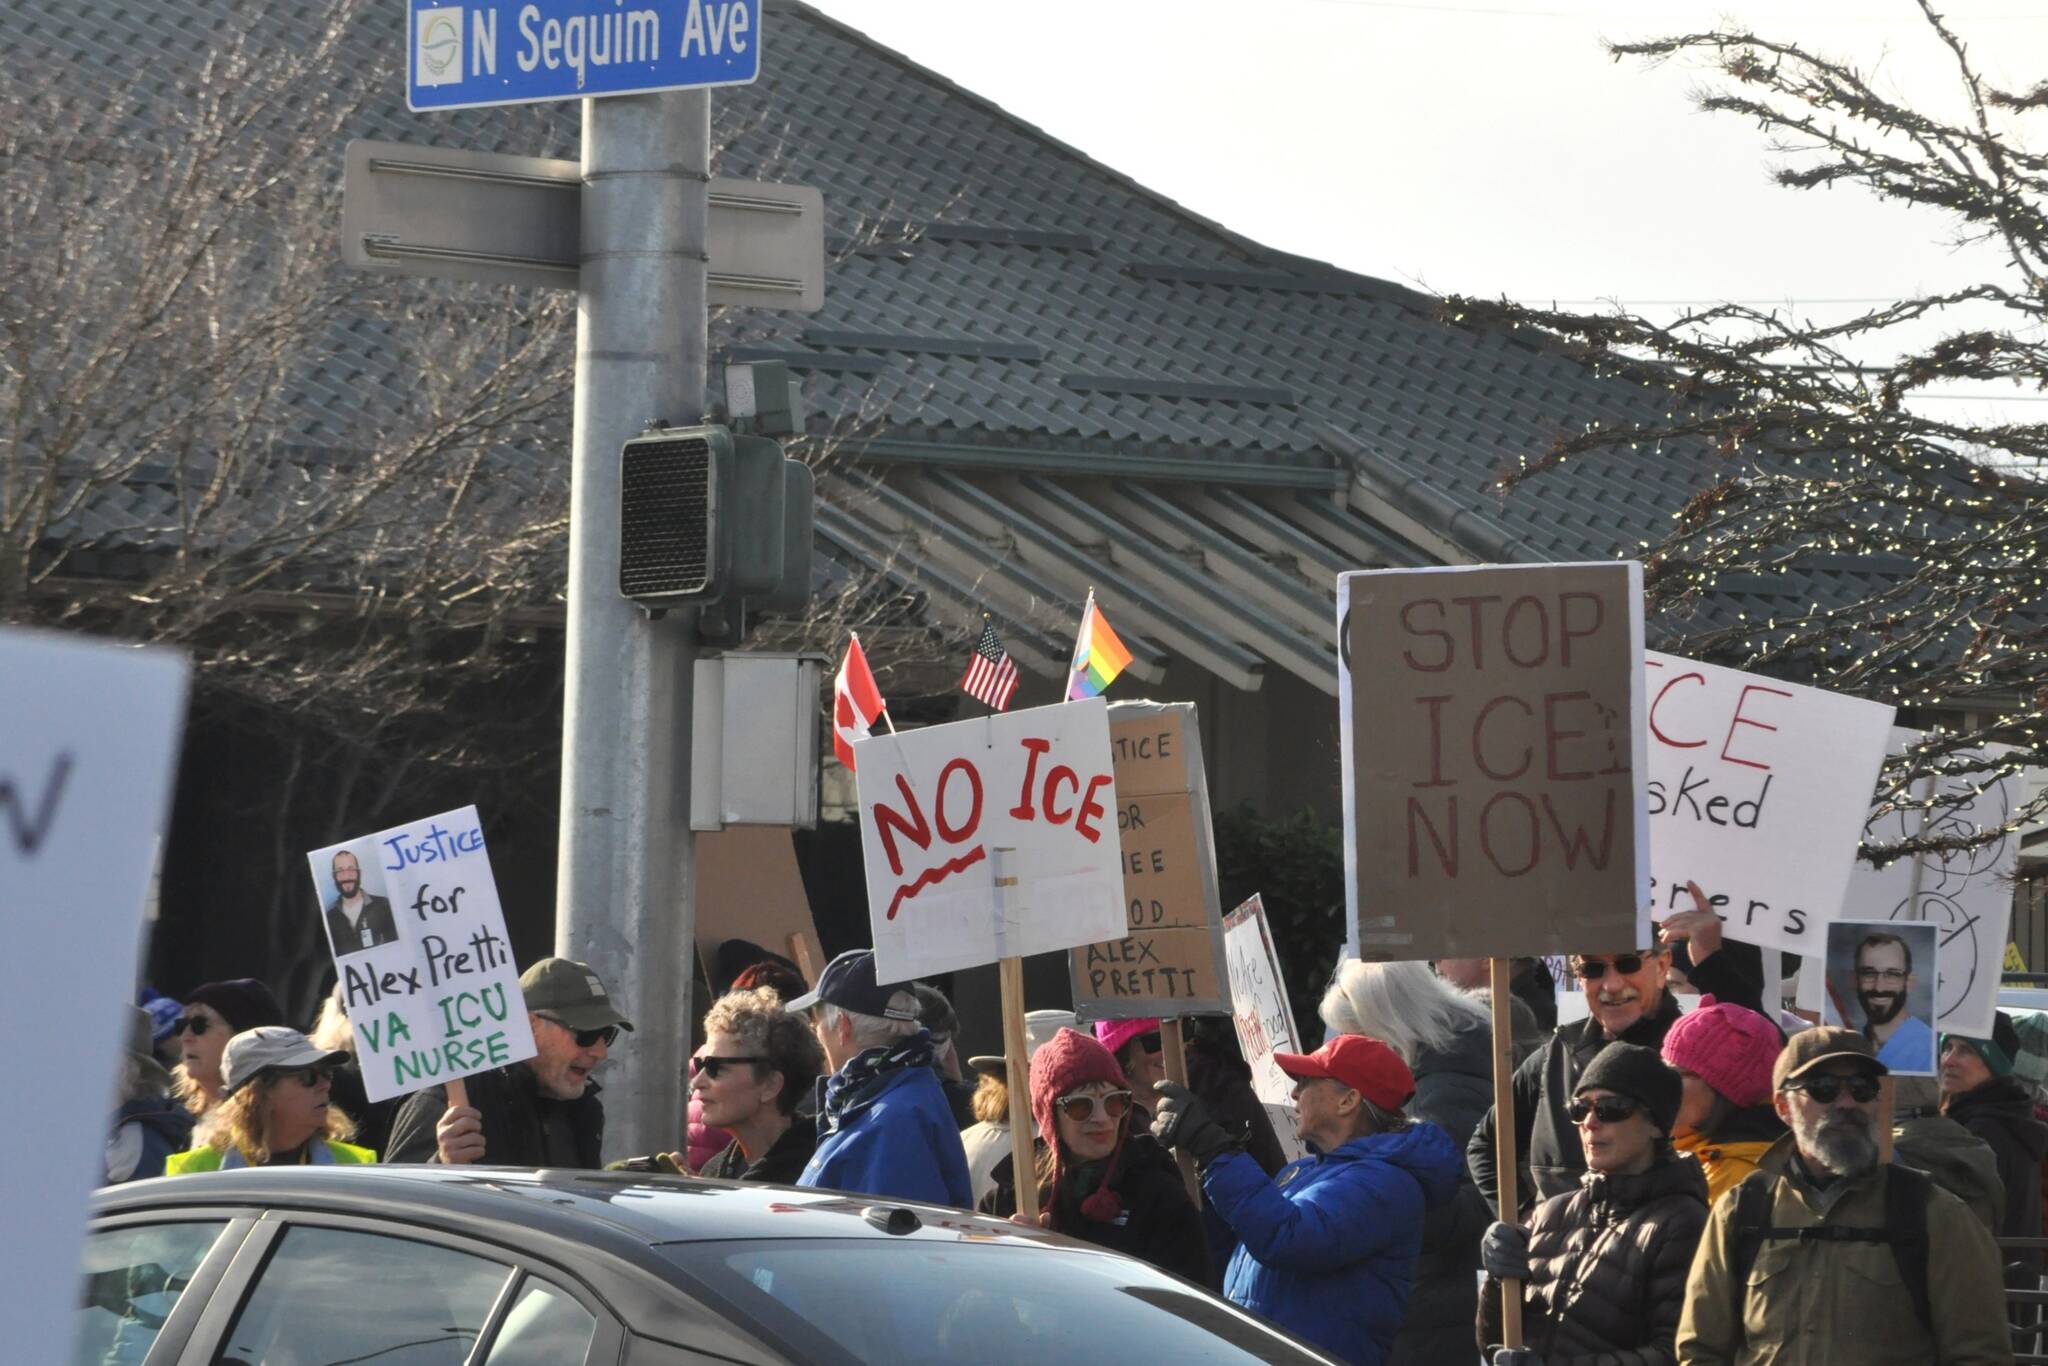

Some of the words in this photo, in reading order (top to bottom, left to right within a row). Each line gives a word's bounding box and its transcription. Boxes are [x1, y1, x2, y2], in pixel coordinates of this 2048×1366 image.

[472, 8, 496, 76] N
[516, 0, 660, 90] Sequim
[680, 0, 749, 58] Ave
[1401, 591, 1605, 673] STOP
[1411, 690, 1595, 788] ICE
[1645, 661, 1793, 770] CE
[1112, 733, 1172, 763] TICE
[873, 757, 984, 876] NO
[1009, 738, 1113, 844] ICE
[1117, 804, 1146, 830] OR
[1407, 788, 1616, 879] NOW
[1121, 849, 1165, 875] EE
[410, 884, 466, 921] for
[1130, 897, 1165, 926] OD
[345, 961, 423, 1008] Alex
[421, 923, 508, 987] Pretti
[1087, 936, 1160, 970] ALEX
[1089, 967, 1196, 998] PRETTI
[359, 1011, 412, 1053] VA
[437, 982, 508, 1039] ICU
[393, 1031, 510, 1085] NURSE
